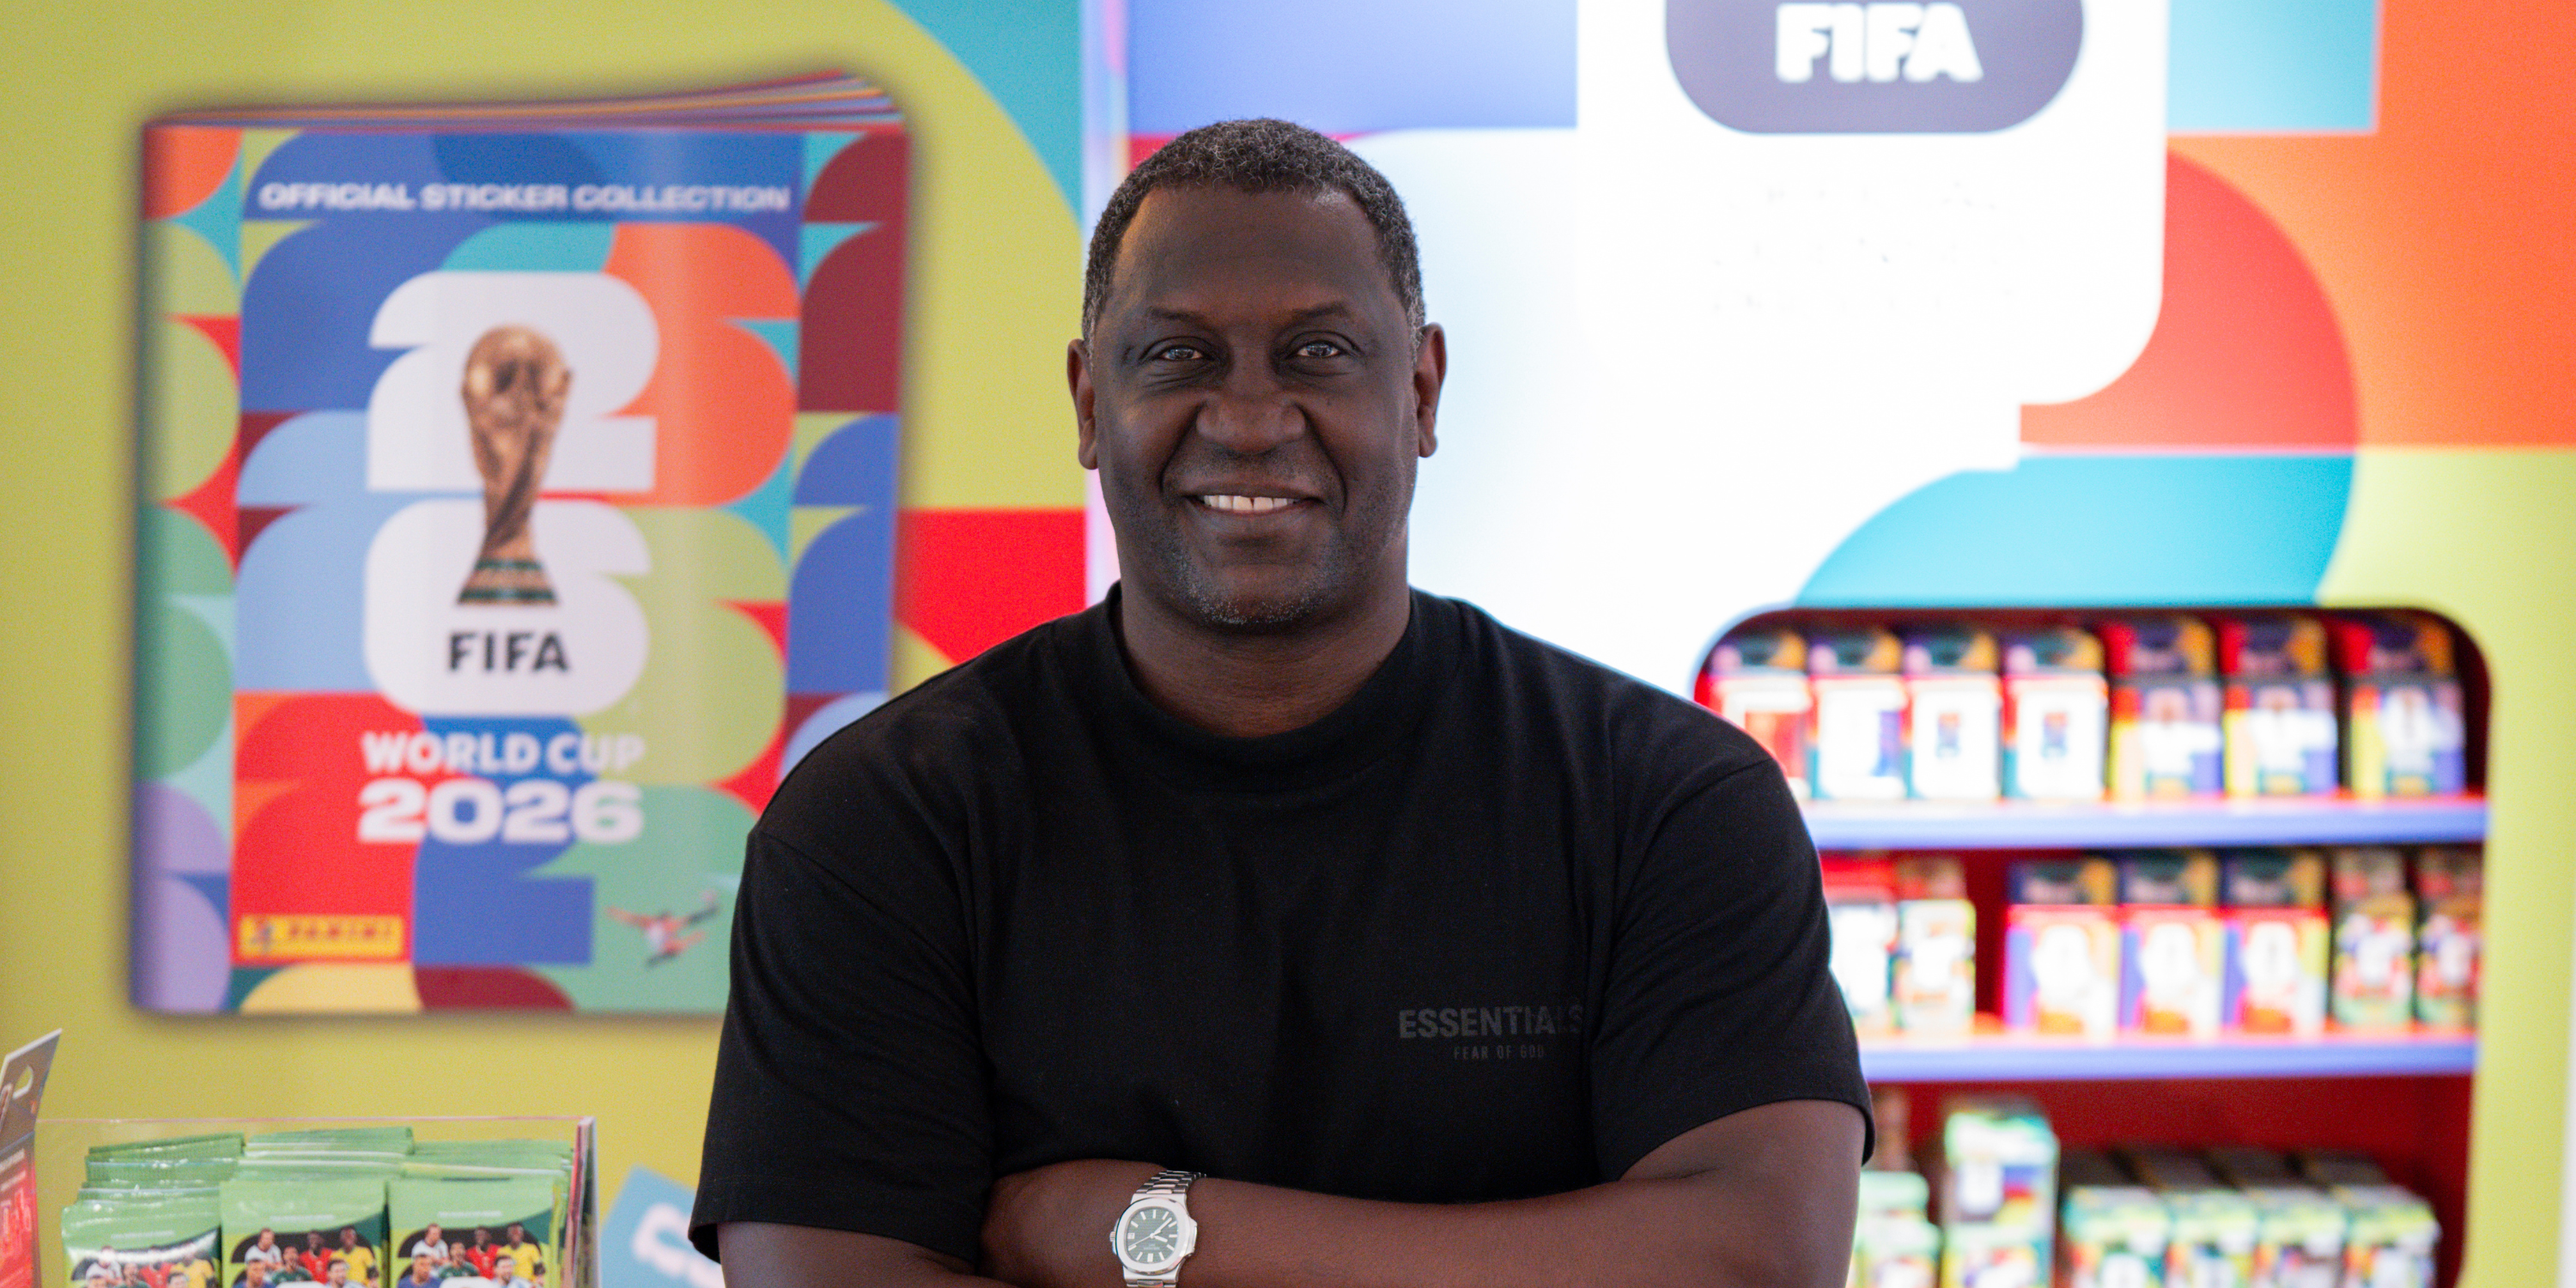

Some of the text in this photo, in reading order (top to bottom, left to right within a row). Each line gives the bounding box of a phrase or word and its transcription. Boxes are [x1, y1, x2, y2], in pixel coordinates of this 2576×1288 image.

[1777, 3, 1984, 82] FIFA
[260, 183, 790, 211] OFFICIAL STICKER COLLECTION
[449, 633, 569, 671] FIFA
[361, 732, 645, 774] WORLD CUP
[358, 779, 643, 843] 2026
[1454, 1045, 1545, 1060] FEAR OF GOD
